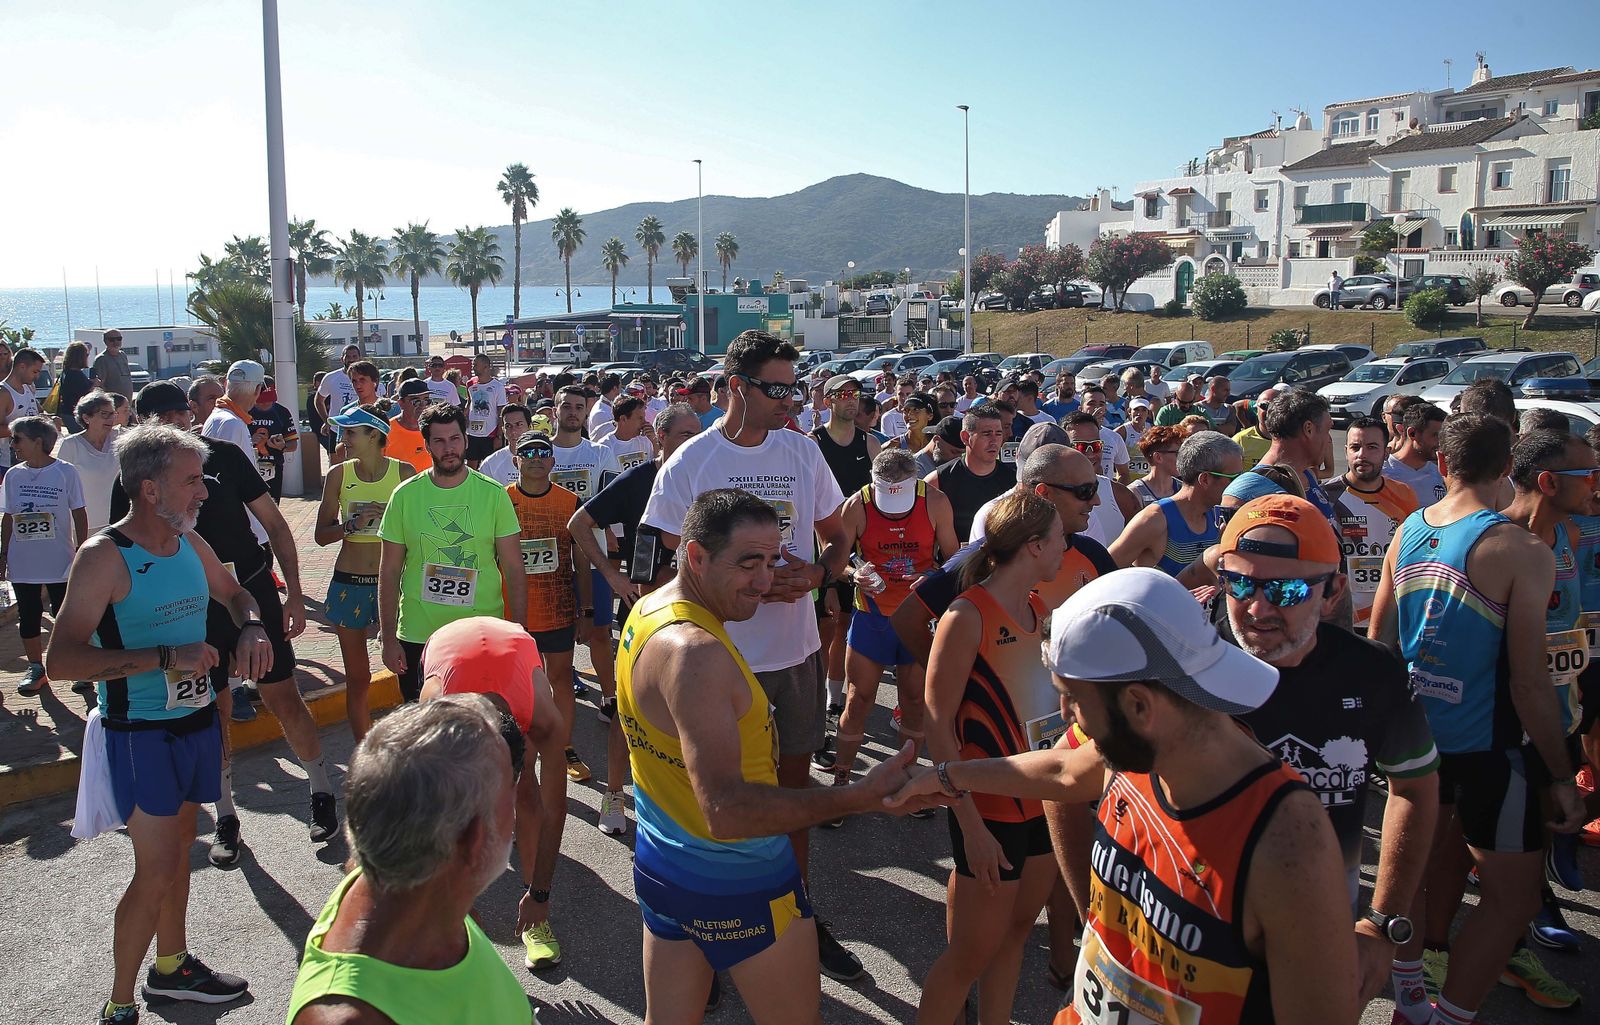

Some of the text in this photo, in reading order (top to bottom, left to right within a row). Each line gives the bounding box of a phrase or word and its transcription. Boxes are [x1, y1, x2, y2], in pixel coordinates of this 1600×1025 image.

[1129, 462, 1149, 470] 210
[728, 474, 796, 483] XXIII EDICIÓN
[17, 521, 50, 534] 323
[878, 540, 920, 550] Lomitos
[428, 577, 471, 596] 328
[693, 918, 742, 930] ATLETISMO
[701, 932, 714, 942] DE
[715, 924, 767, 941] ALGECIRAS
